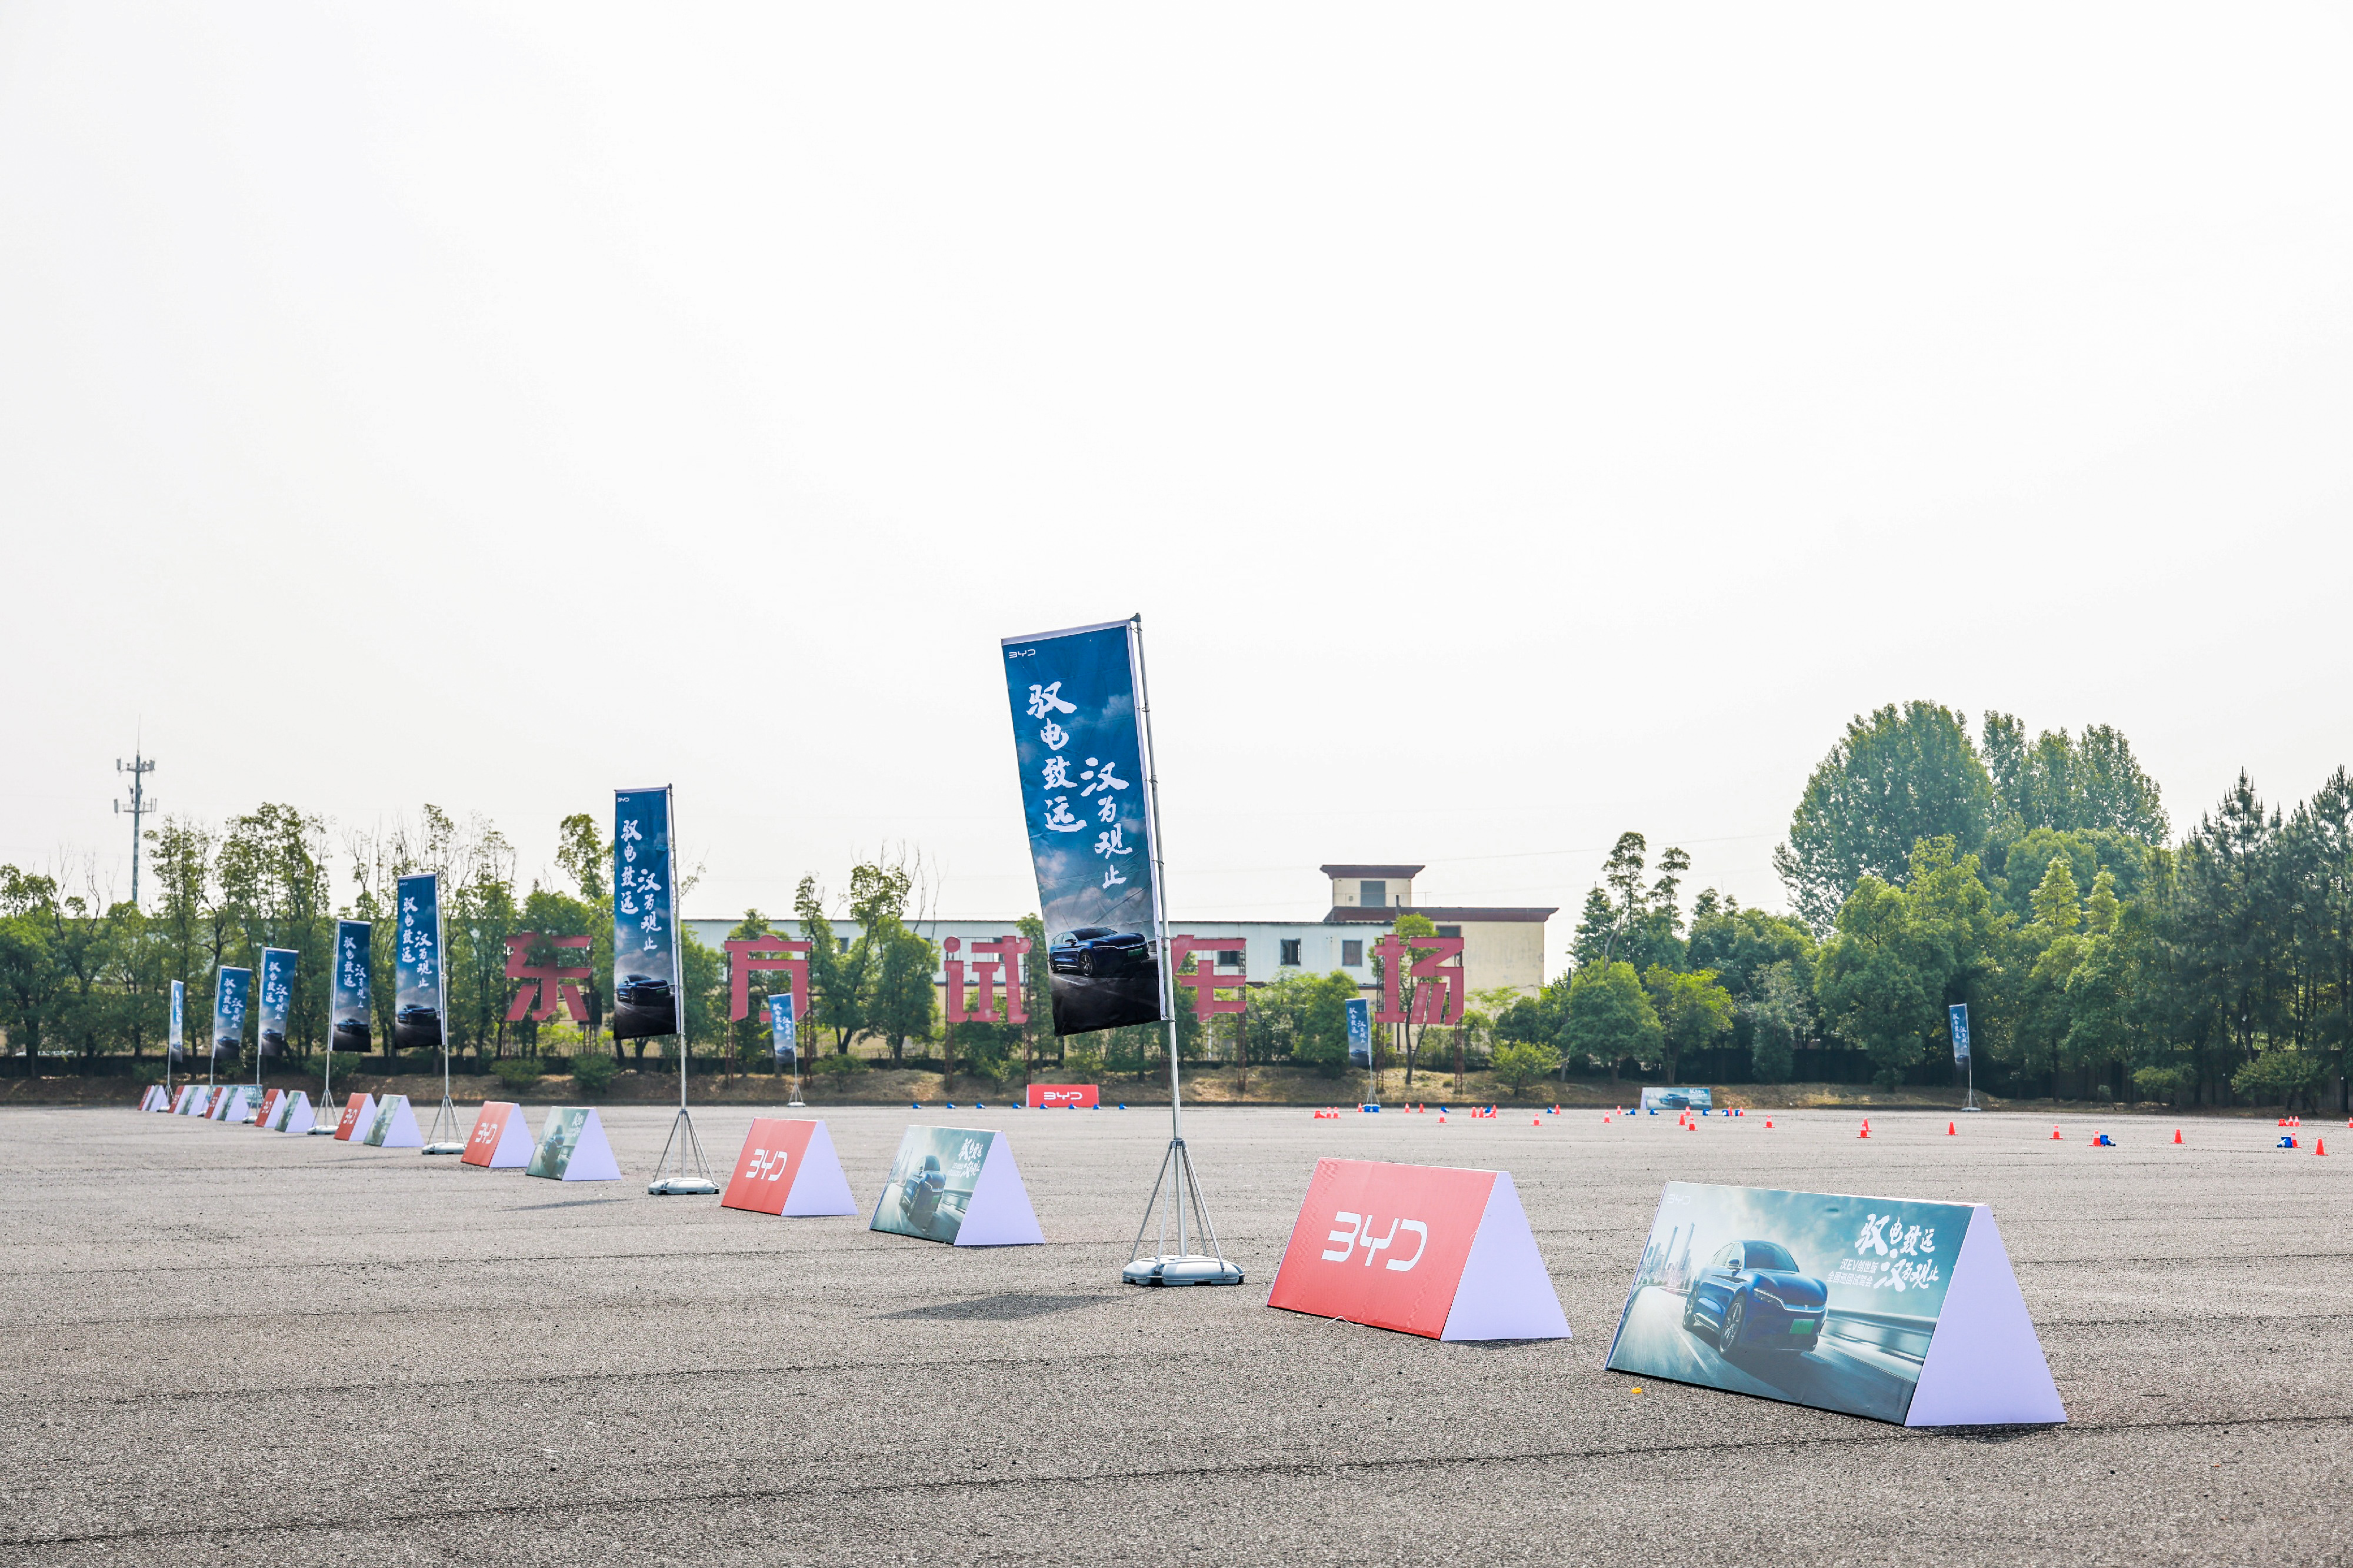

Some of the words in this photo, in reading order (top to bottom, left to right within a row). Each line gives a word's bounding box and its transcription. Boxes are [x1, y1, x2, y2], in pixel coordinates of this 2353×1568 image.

[1008, 649, 1036, 658] BYD
[1026, 681, 1086, 833] 驭电致远
[1080, 757, 1133, 890] 汉为观止
[621, 819, 642, 915] 驭电致远
[637, 869, 662, 952] 汉为观止
[1044, 1091, 1083, 1100] BYD
[475, 1122, 498, 1144] BYD
[745, 1149, 788, 1181] BYD
[1667, 1193, 1691, 1205] BYD
[1320, 1210, 1428, 1272] BYD
[1855, 1213, 1935, 1256] 驭电致远
[1827, 1270, 1873, 1287] 全国巡回试驾会
[1839, 1258, 1879, 1273] 汉EV创世版
[1874, 1249, 1939, 1292] 汉为观止
